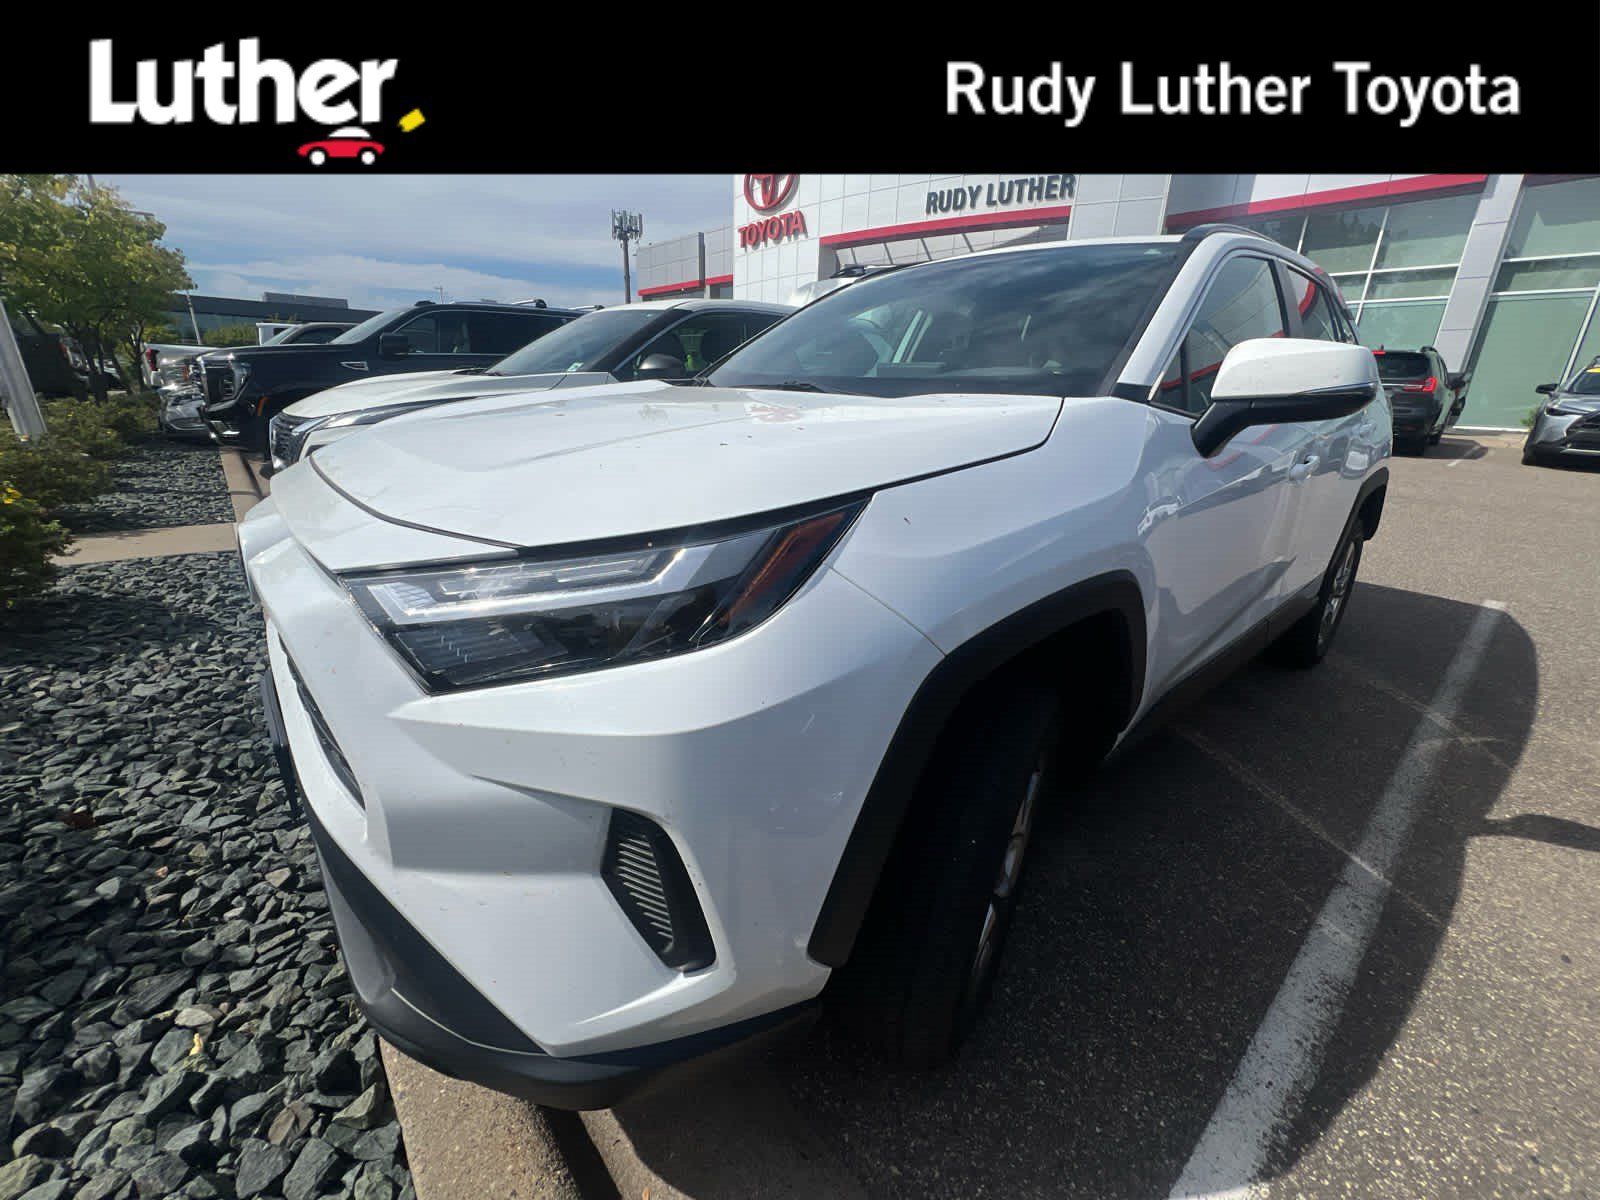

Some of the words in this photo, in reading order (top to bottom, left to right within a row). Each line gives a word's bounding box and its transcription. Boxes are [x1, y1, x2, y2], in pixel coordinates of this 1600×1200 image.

[926, 185, 981, 214] RUDY
[986, 174, 1076, 205] LUTHER
[738, 211, 806, 249] TOYOTA
